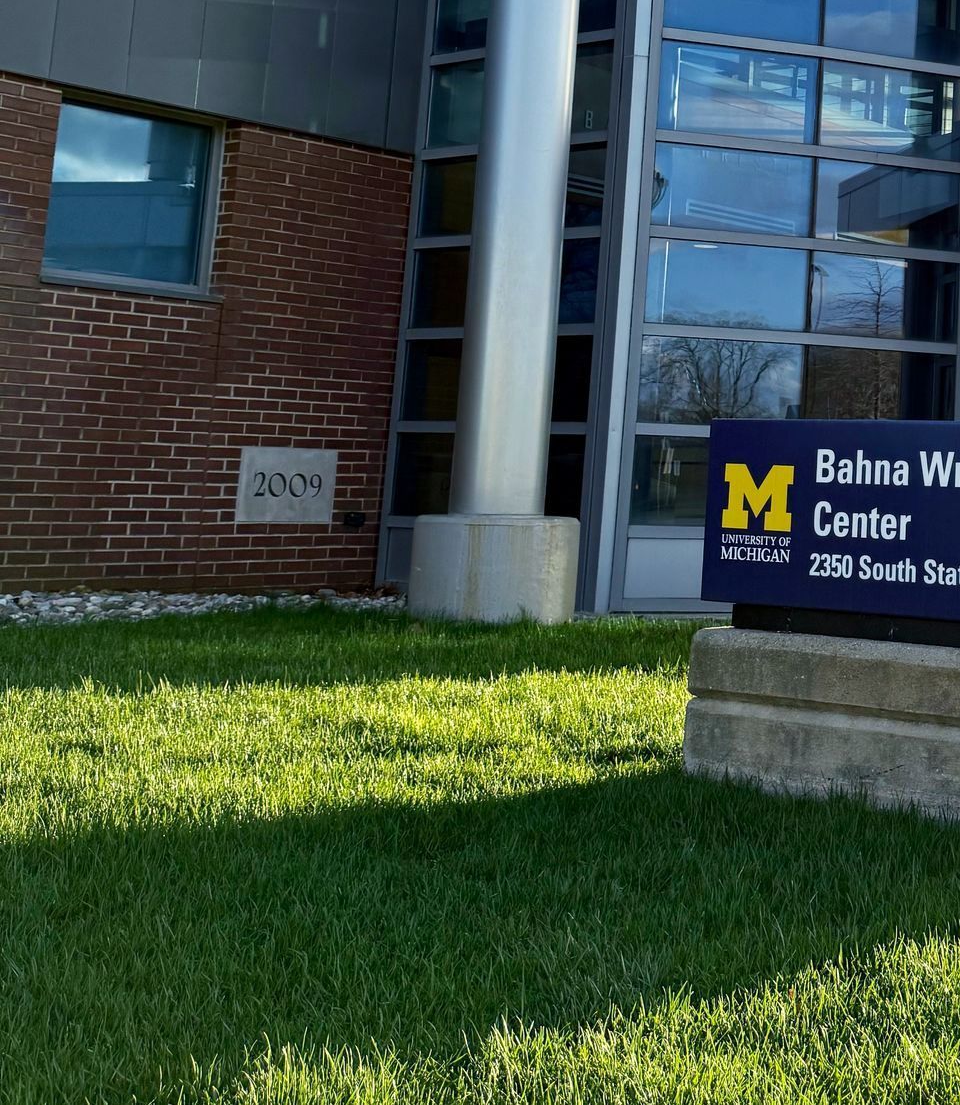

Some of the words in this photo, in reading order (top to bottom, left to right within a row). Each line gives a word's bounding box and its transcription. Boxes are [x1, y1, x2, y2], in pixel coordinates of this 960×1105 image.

[815, 448, 909, 486] Bahna
[253, 472, 322, 498] 2009
[722, 463, 795, 532] M
[813, 500, 912, 541] Center
[720, 546, 791, 564] MICHIGAN
[721, 533, 777, 546] UNIVERSITY
[778, 536, 792, 547] OF
[809, 552, 853, 579] 2350
[858, 554, 917, 583] South
